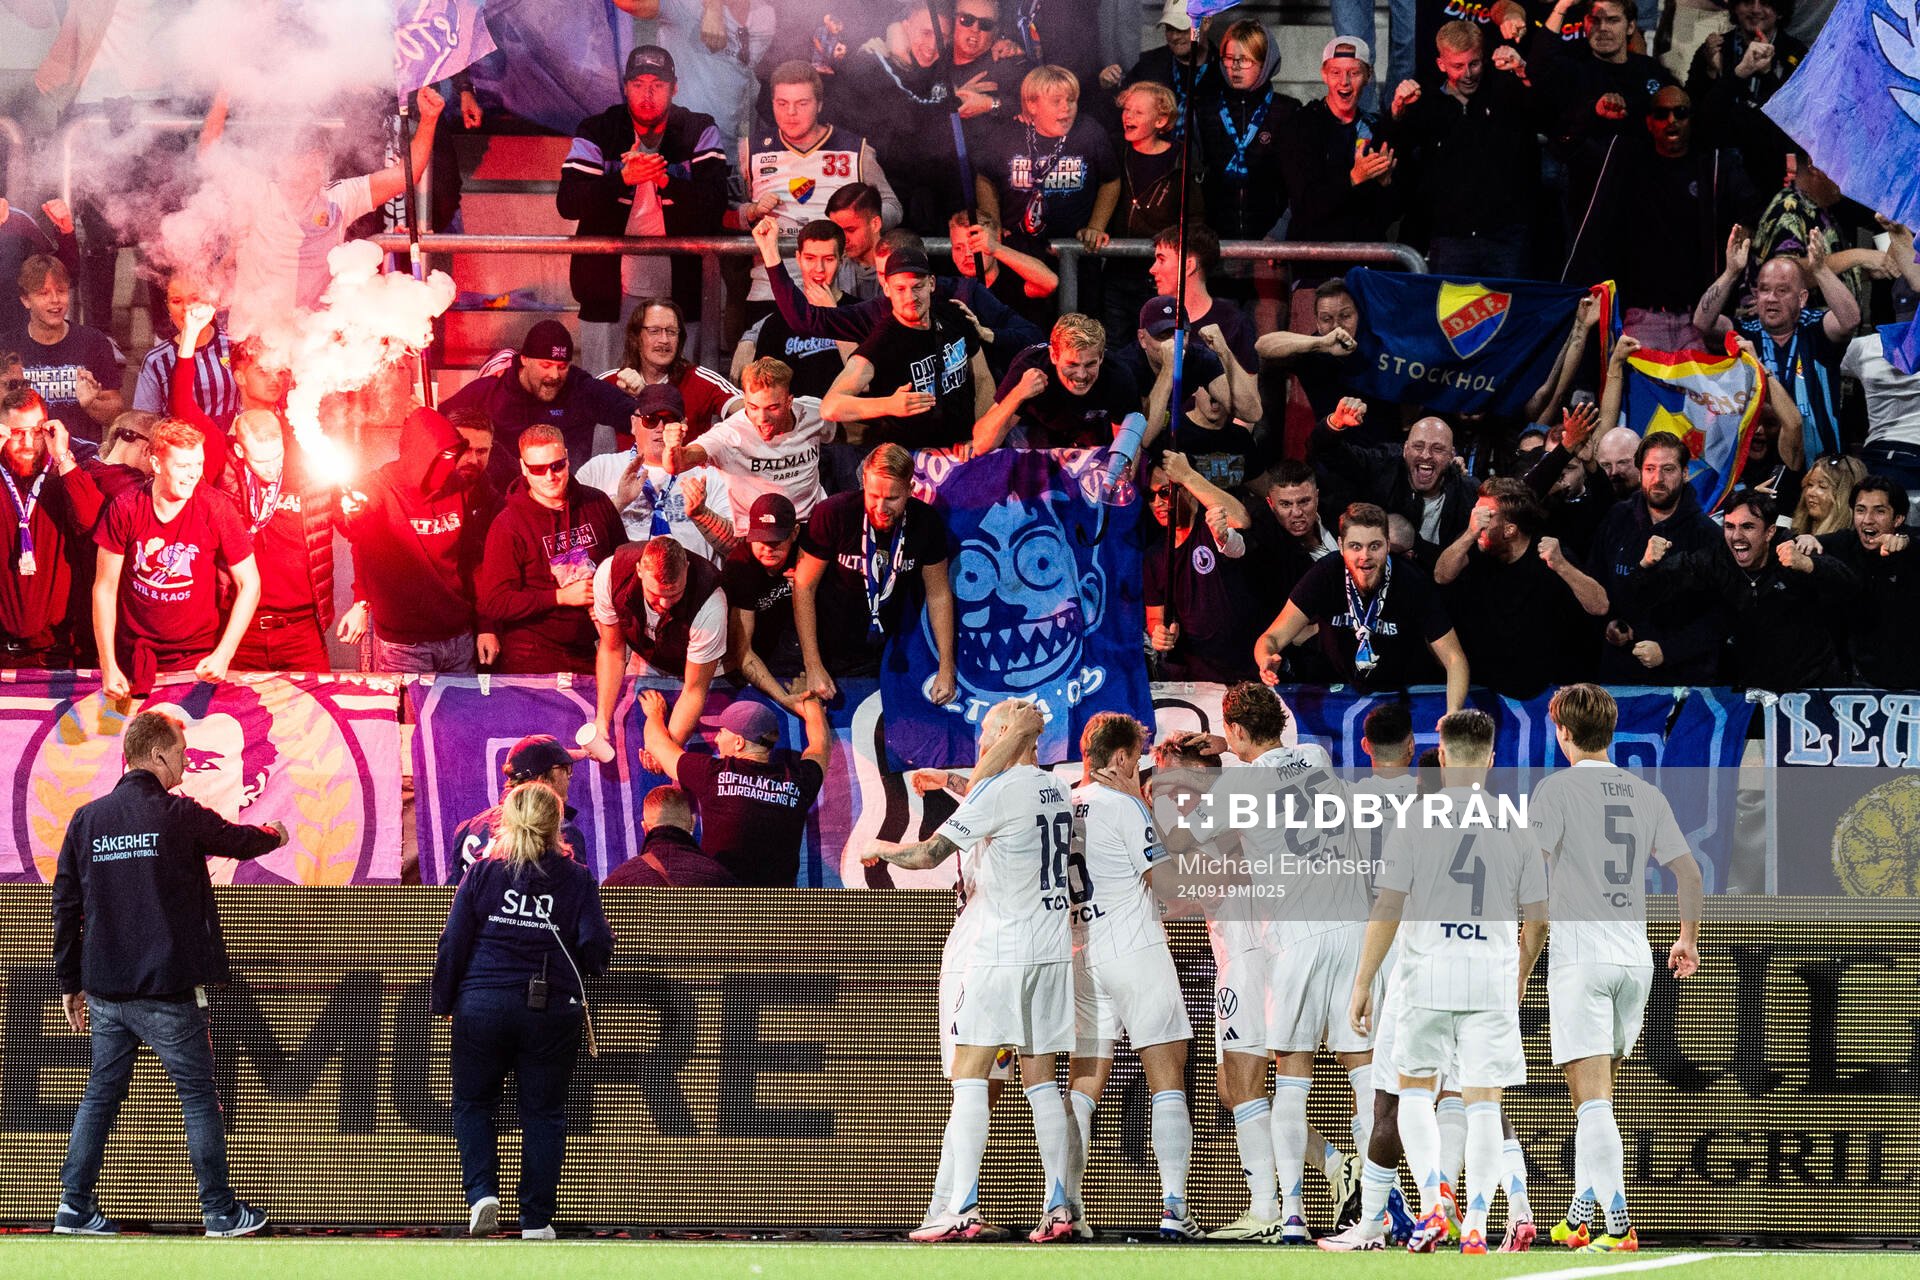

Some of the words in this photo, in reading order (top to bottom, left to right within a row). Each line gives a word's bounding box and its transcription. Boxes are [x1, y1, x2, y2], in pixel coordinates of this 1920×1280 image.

[822, 153, 851, 177] 33
[1012, 171, 1082, 189] ULRAS
[750, 444, 819, 472] BALMAIN
[773, 470, 799, 482] PARIS
[837, 553, 916, 572] ULTAS
[132, 581, 150, 597] STIL
[160, 590, 192, 603] KAOS
[1600, 782, 1635, 798] TENHO
[92, 833, 160, 853] SÄKERHET
[1036, 811, 1073, 891] 18
[1604, 804, 1636, 885] 5
[92, 850, 132, 863] DJURGÅRDEN
[132, 848, 160, 859] FOTBOLL
[1448, 833, 1486, 917] 4
[1070, 903, 1106, 925] TCL
[1440, 923, 1488, 941] TCL
